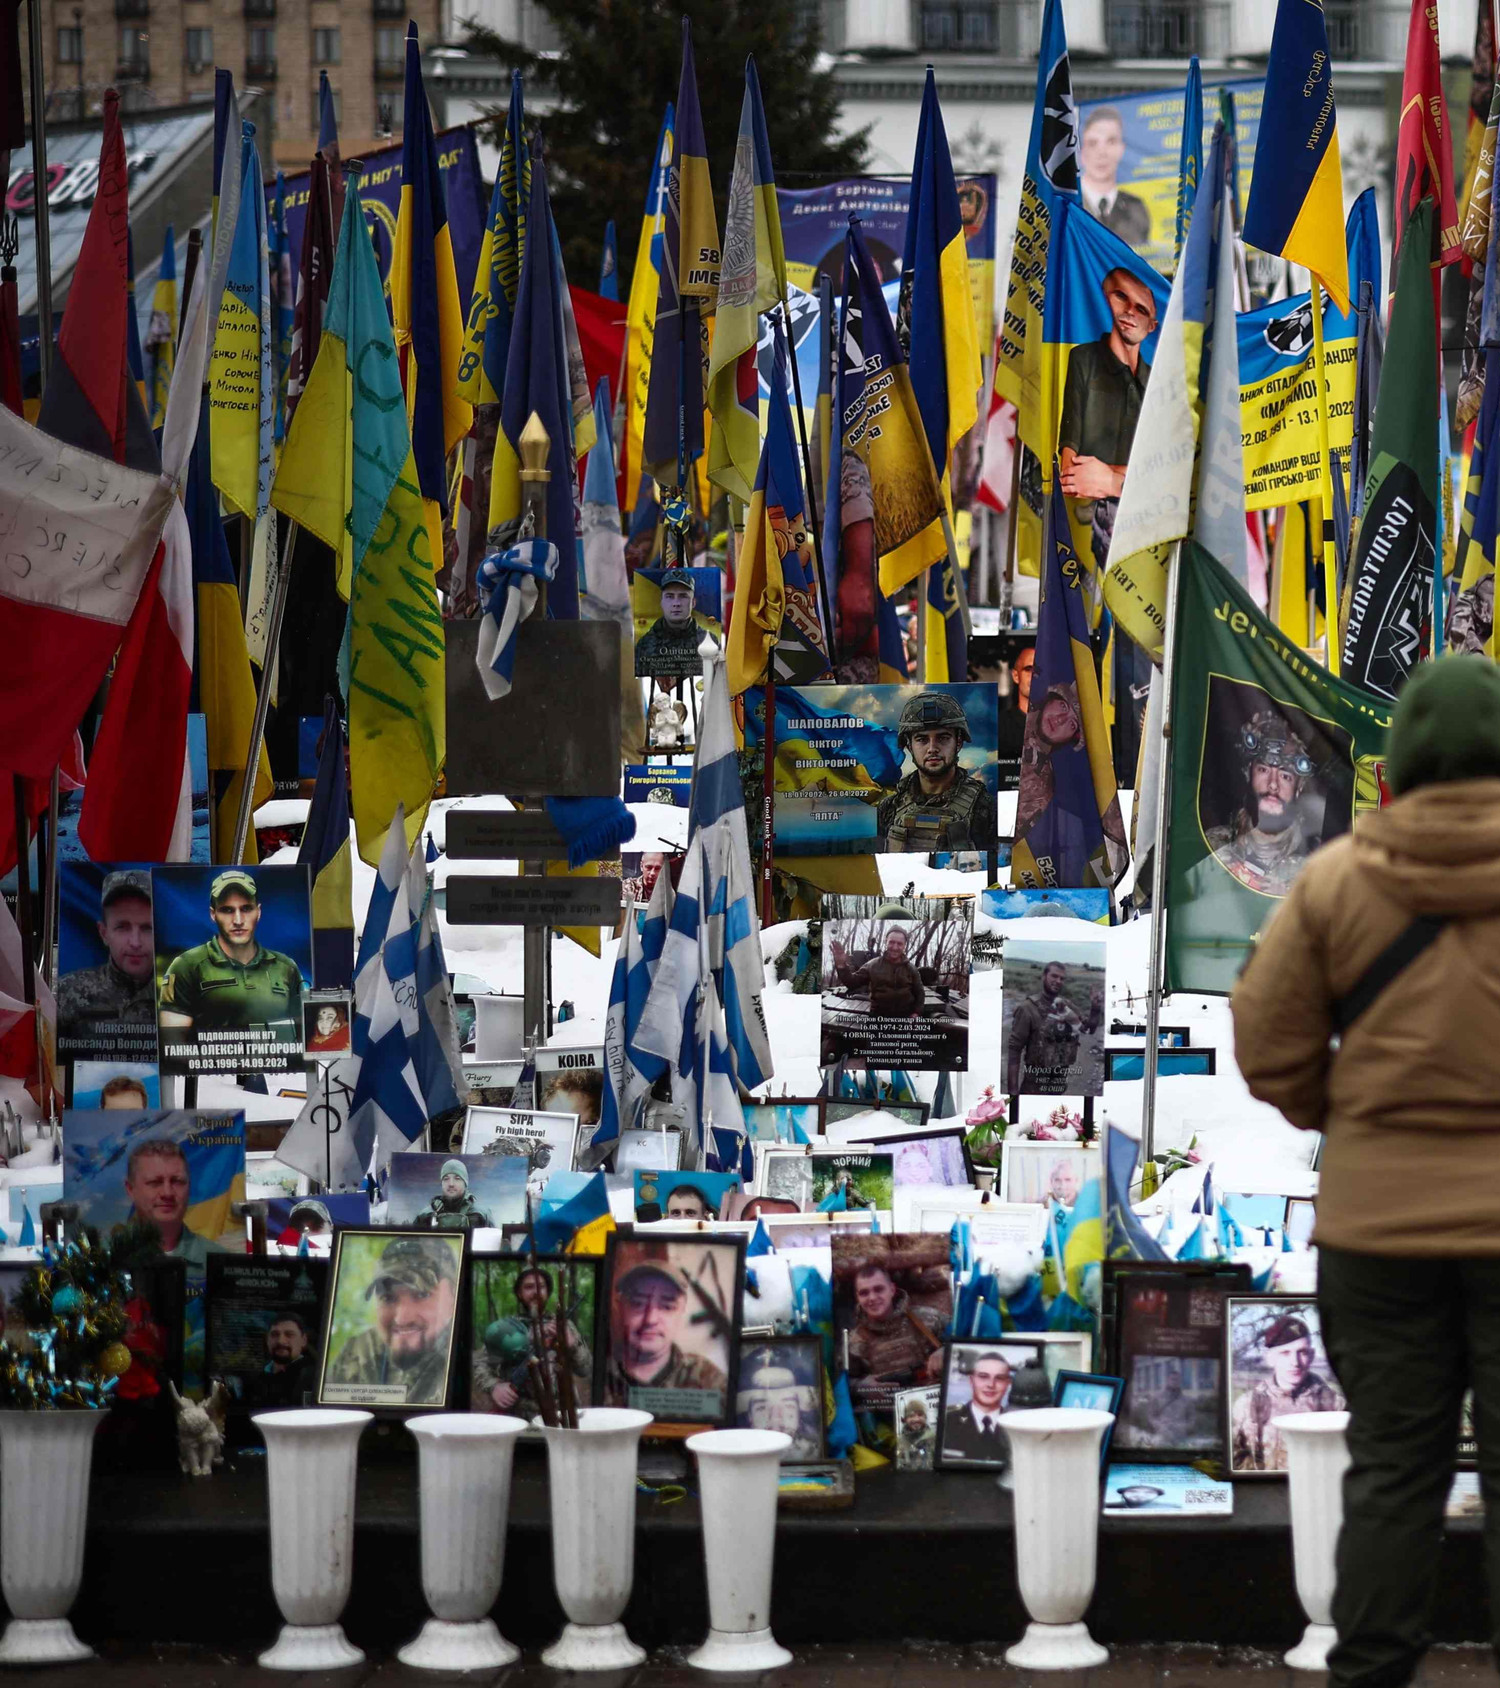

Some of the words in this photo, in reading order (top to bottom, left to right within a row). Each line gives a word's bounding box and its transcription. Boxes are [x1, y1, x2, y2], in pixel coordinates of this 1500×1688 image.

[1297, 400, 1355, 426] 13.1.2022
[787, 716, 865, 731] ШАПОВАЛОВ
[808, 739, 844, 750] ВІКТОР
[795, 758, 857, 770] ВІКТОРОВИЧ
[878, 1015, 915, 1024] Олександр
[58, 1037, 116, 1049] Олександр
[197, 1030, 262, 1043] ПІДПОЛКОВНИК
[261, 1030, 277, 1040] НГУ
[164, 1043, 199, 1057] ГАНЖА
[200, 1042, 245, 1056] ОЛЕКСІЙ
[870, 1040, 900, 1048] танкової
[188, 1057, 288, 1070] 09.03.1996-14.09.2024
[557, 1052, 596, 1069] KOIRA
[509, 1113, 534, 1127] SIPA
[495, 1126, 510, 1137] Fly
[511, 1126, 527, 1138] high
[832, 1152, 872, 1168] ЧОРНИЙ
